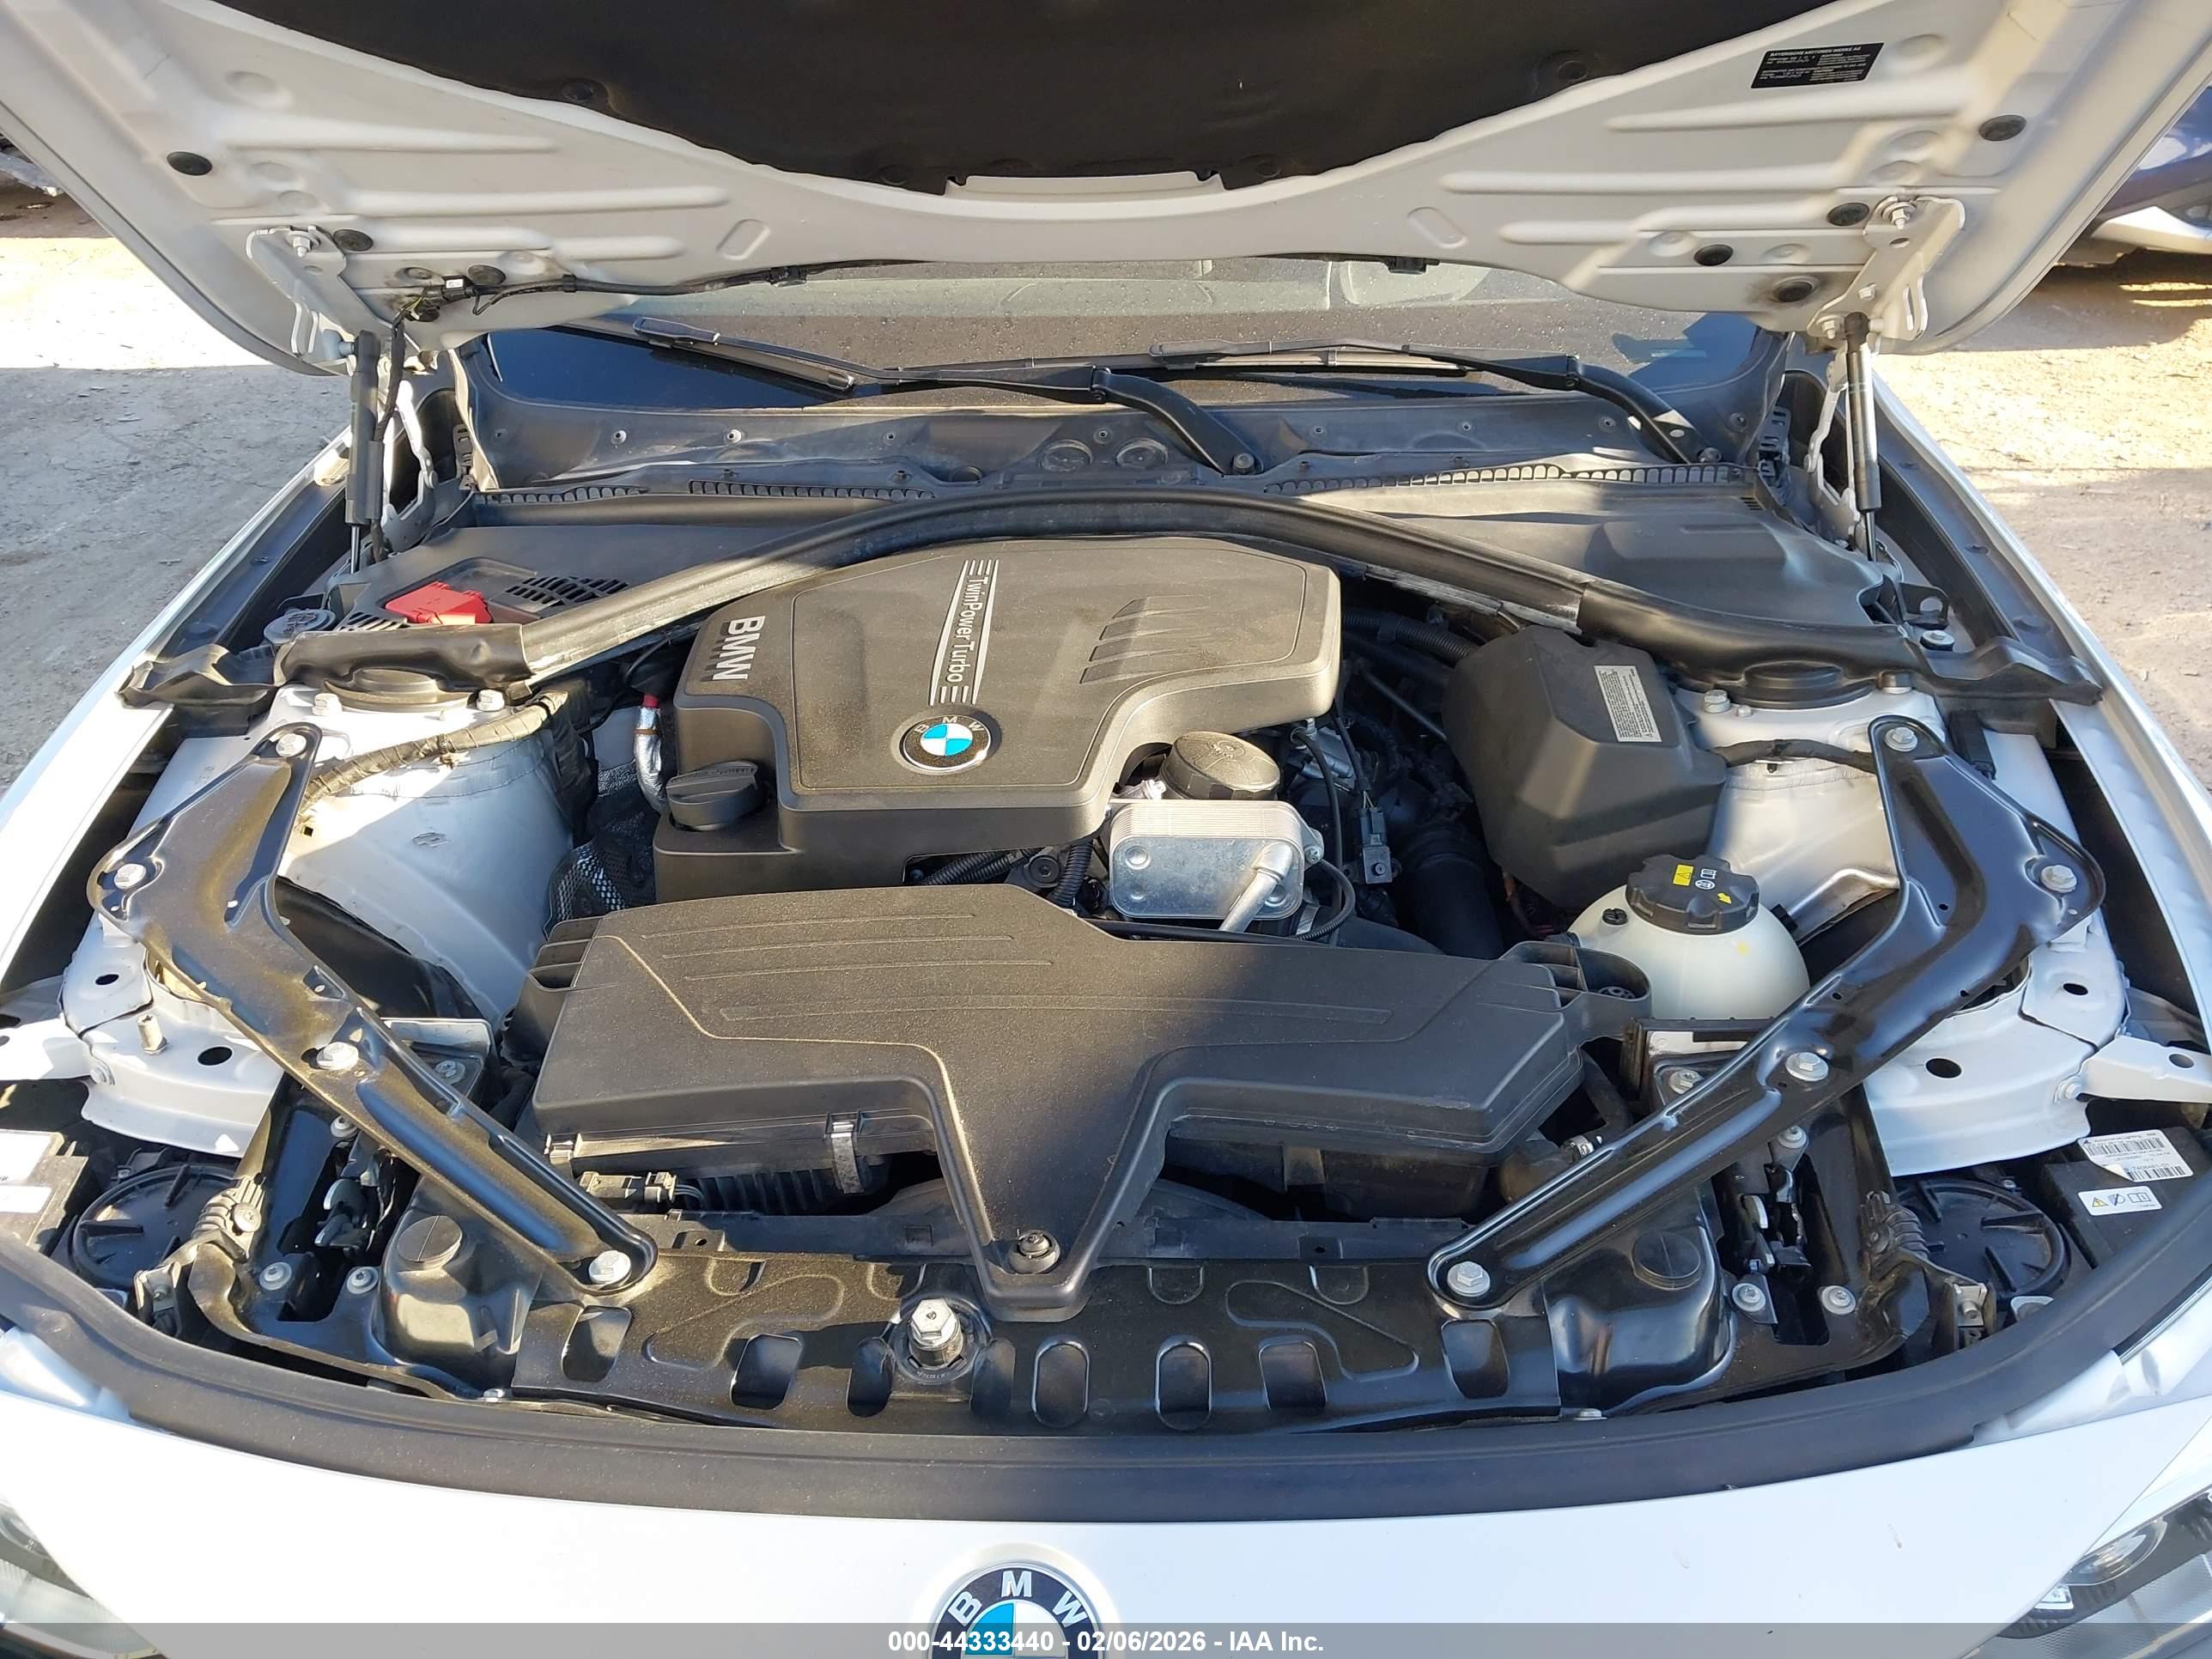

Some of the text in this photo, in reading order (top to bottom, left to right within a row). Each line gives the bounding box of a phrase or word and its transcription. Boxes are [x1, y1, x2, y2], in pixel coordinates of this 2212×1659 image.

[712, 616, 766, 680] BMW
[946, 577, 988, 683] TwinPower Turbo
[915, 716, 984, 733] BMW
[948, 1571, 1088, 1628] BMW
